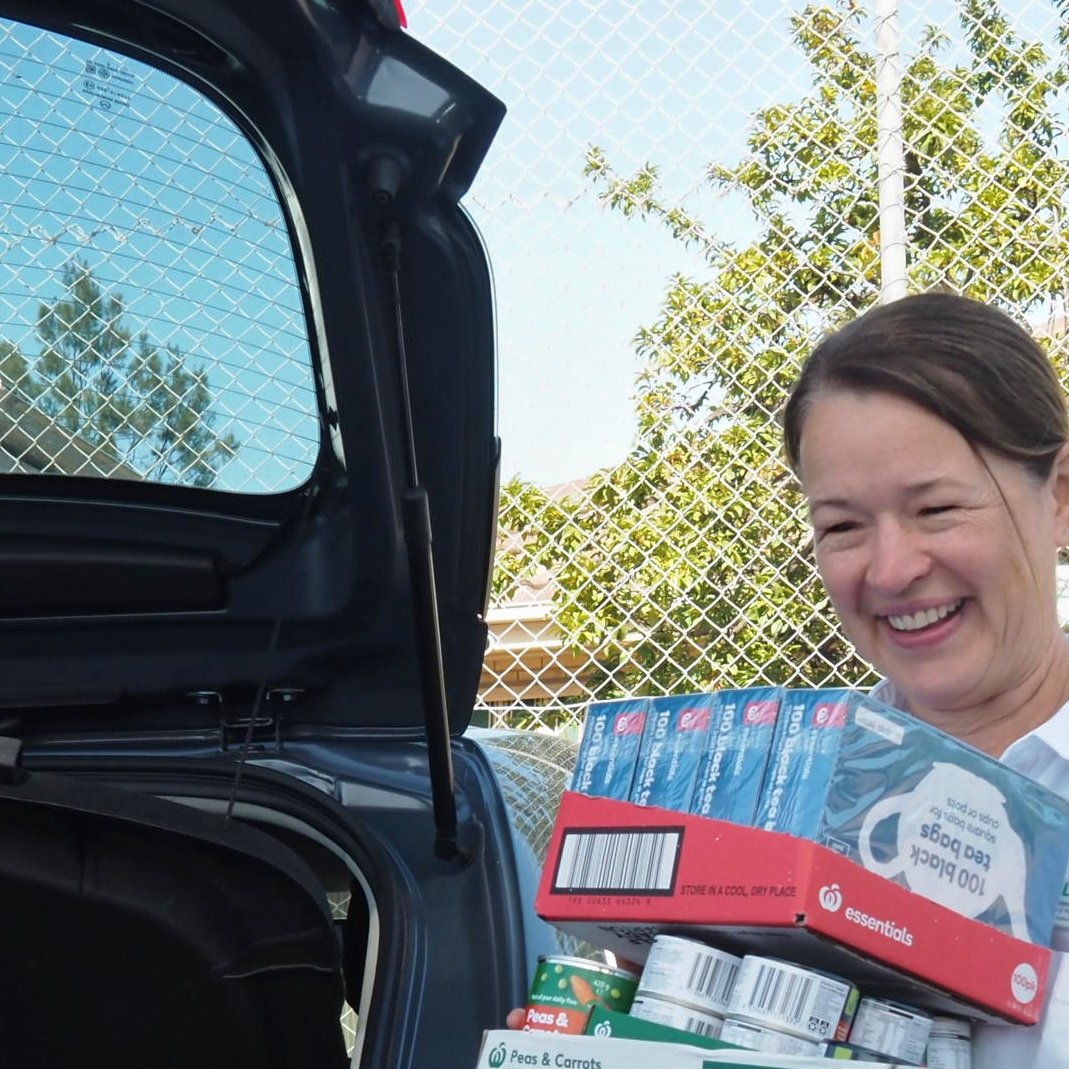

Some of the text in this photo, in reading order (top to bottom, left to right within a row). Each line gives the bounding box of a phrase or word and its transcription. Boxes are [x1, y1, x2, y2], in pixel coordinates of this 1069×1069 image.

[655, 710, 670, 739] 100
[789, 704, 805, 735] 100
[581, 714, 607, 791] 100 black
[643, 742, 663, 788] black
[702, 703, 736, 814] 100 black tea
[775, 737, 796, 786] black
[768, 787, 784, 818] tea
[920, 823, 991, 872] tea bags
[910, 844, 985, 896] 100 black
[680, 885, 707, 896] STORE
[707, 885, 716, 896] IN
[716, 885, 723, 896] A
[750, 886, 769, 896] DRY
[769, 886, 798, 897] PLACE
[845, 907, 914, 946] essentials
[1013, 973, 1036, 992] 100pk
[526, 1008, 568, 1028] Peas &
[510, 1049, 538, 1065] Peas
[542, 1052, 551, 1067] &
